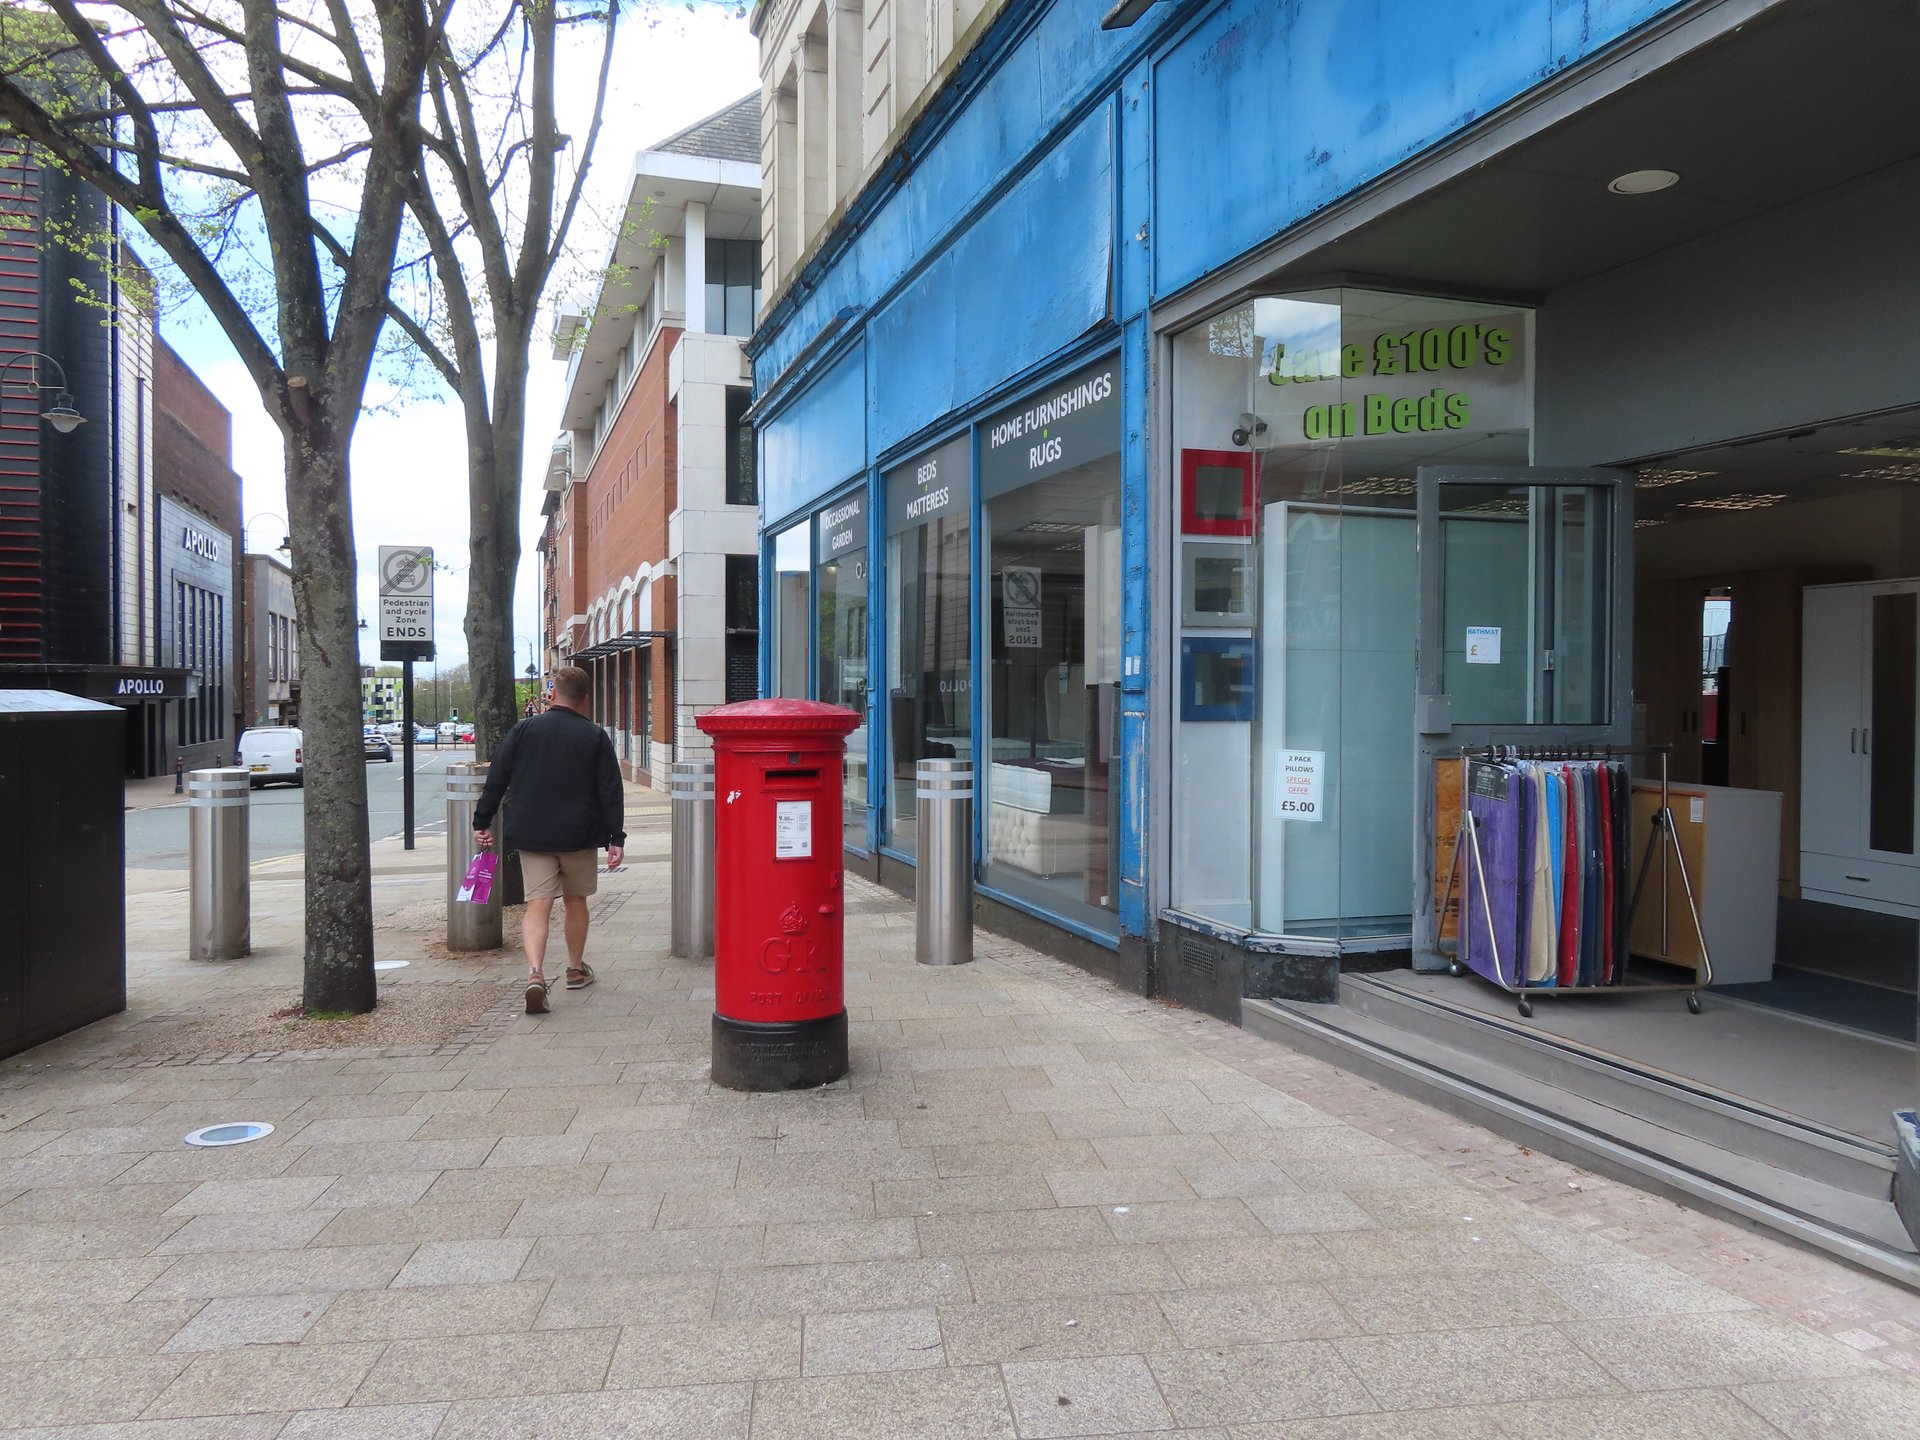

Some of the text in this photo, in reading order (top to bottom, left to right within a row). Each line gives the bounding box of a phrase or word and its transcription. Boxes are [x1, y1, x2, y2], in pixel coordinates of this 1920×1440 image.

[1372, 324, 1512, 376] £100's
[991, 372, 1111, 449] HOME FURNISHINGS
[1303, 387, 1471, 440] on Beds
[1029, 436, 1062, 470] RUGS
[917, 460, 937, 485] BEDS
[825, 499, 860, 529] OCCASSIONAL
[906, 486, 949, 520] MATTERESS
[184, 527, 218, 562] APOLLO
[832, 528, 853, 550] GARDEN
[404, 608, 427, 616] cycle
[387, 626, 426, 637] ENDS
[118, 679, 164, 694] APOLLO
[1286, 776, 1311, 784] SPECIAL
[1281, 800, 1315, 812] £5.00
[750, 992, 783, 1006] POST
